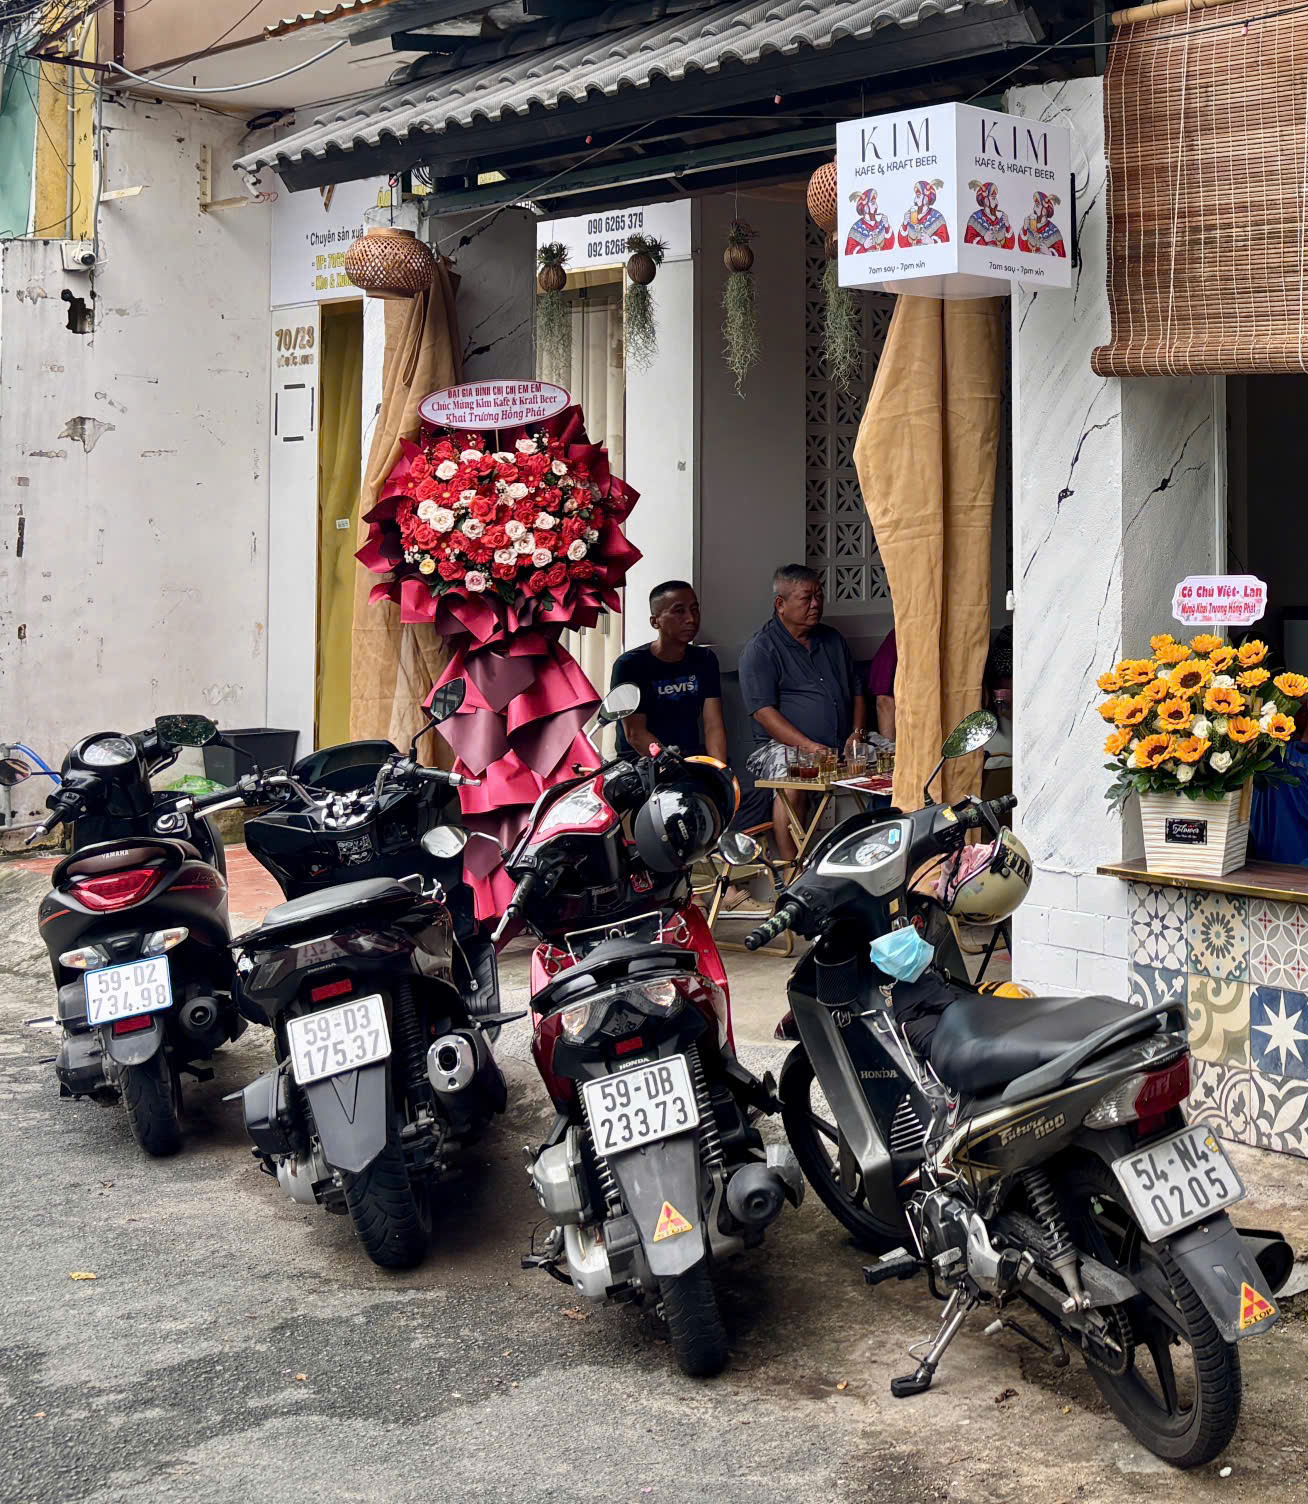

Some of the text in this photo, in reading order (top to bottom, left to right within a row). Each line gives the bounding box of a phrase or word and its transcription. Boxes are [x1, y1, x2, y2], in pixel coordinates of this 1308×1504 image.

[861, 117, 930, 163] KIM
[981, 118, 1048, 167] KIM
[855, 155, 938, 177] KAFE & KRAFT BEER
[974, 156, 1055, 181] KAFE & KRAFT BEER
[587, 211, 644, 235] 090 6265 379
[310, 229, 336, 247] Chuyên
[351, 224, 364, 240] xuấ
[587, 241, 603, 258] 092
[605, 239, 625, 256] 6265
[461, 387, 473, 398] GIA
[518, 384, 529, 394] EM
[530, 383, 542, 393] EM
[431, 400, 451, 412] Chúc
[475, 398, 492, 408] Kim
[511, 396, 518, 406] &
[519, 394, 538, 405] Kraft
[540, 394, 558, 404] Beer
[446, 411, 467, 423] Khai
[1243, 585, 1262, 598] Lan
[101, 849, 129, 860] YAMAHA
[98, 962, 158, 994] 59-D2
[92, 983, 168, 1021] 734.98
[303, 1003, 372, 1046] 59-D3
[303, 1029, 382, 1077] 175.37
[618, 1057, 650, 1071] HONDA
[860, 1069, 899, 1079] HONDA
[600, 1066, 675, 1113] 59-DB
[600, 1096, 689, 1150] 233.73
[1130, 1132, 1209, 1193] 54-N4
[1150, 1167, 1230, 1228] 0205
[1243, 1308, 1273, 1328] STOP
